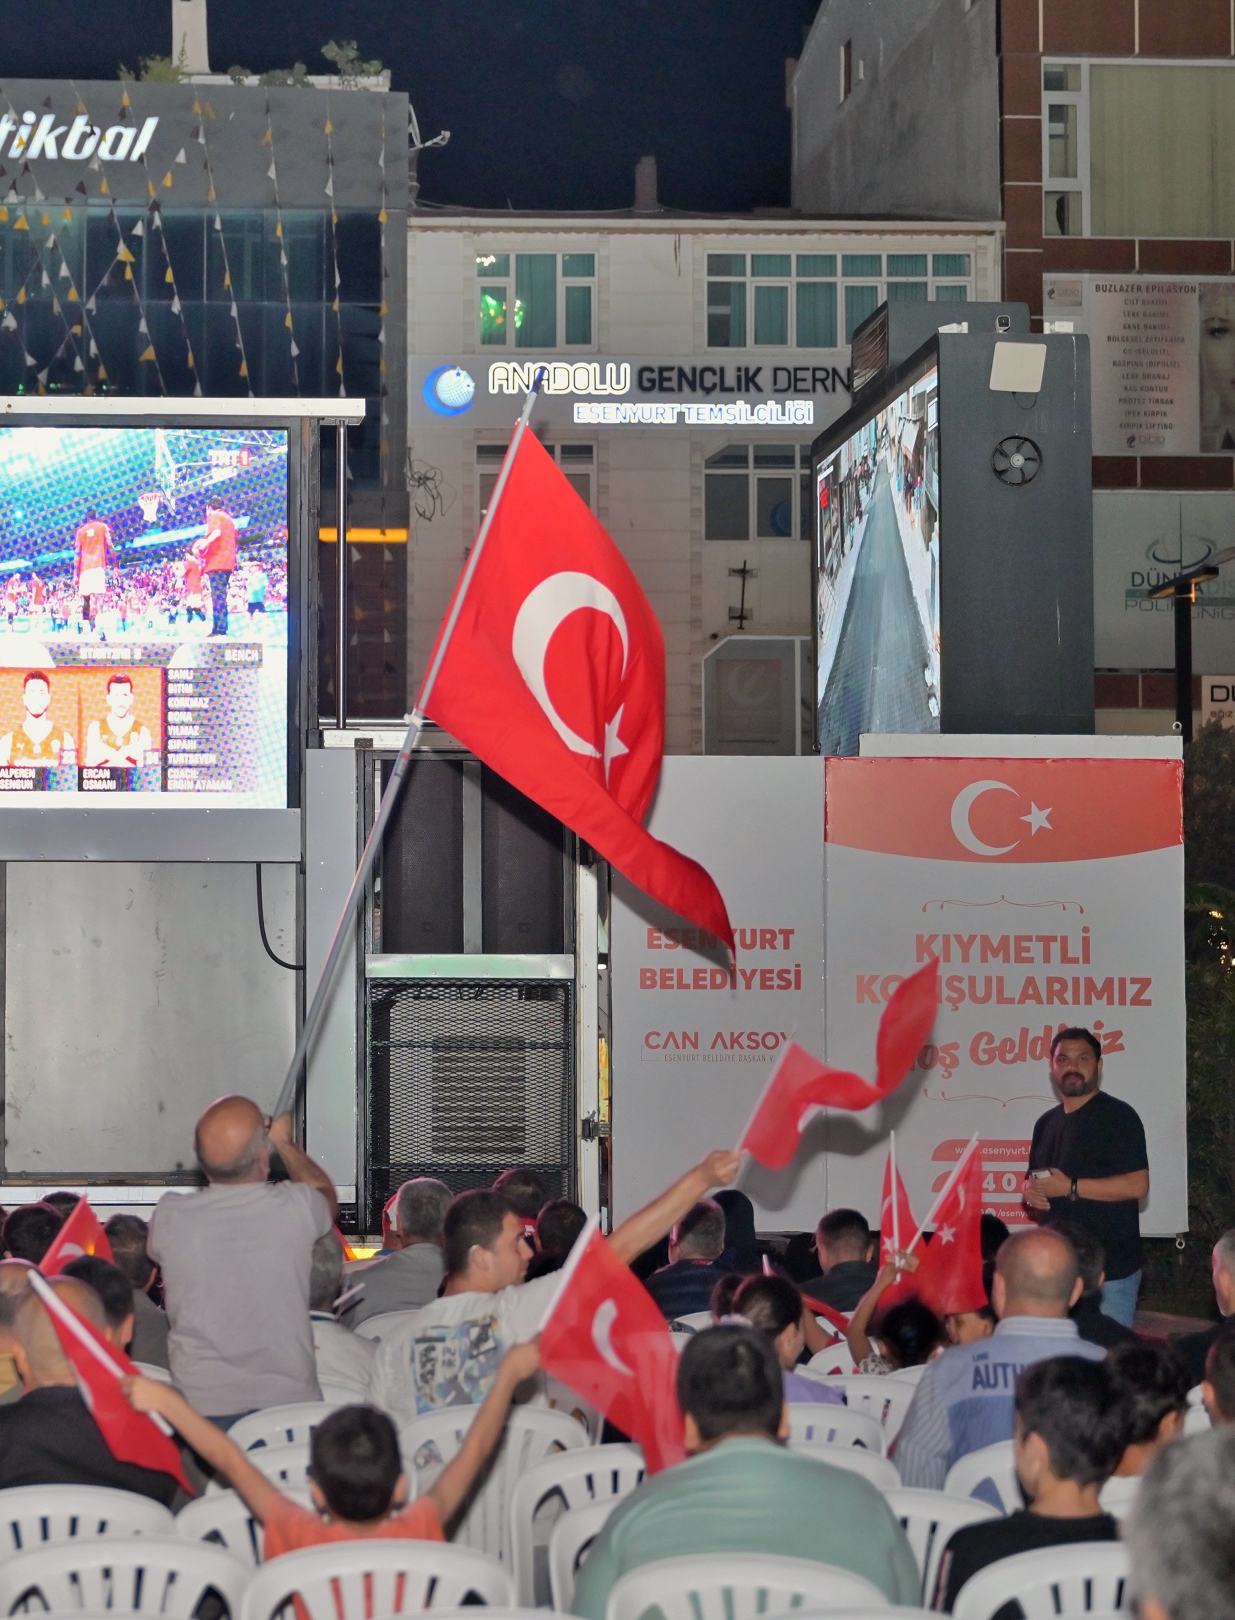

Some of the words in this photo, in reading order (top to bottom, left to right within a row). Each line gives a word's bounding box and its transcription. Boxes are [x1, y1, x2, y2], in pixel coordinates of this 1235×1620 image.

[1095, 283, 1142, 293] BUZLAZER
[490, 363, 630, 394] ANADOLU
[575, 403, 679, 423] ESENYURT
[224, 649, 259, 662] BENCH
[0, 768, 36, 779] ALPEREN
[82, 768, 111, 779] ERCAN
[915, 925, 1091, 965] KIYMETLİ
[639, 963, 802, 991] BELEDİYESİ
[855, 974, 1152, 1011] KOŞULARIMIZ
[644, 1031, 699, 1050] CAN
[664, 1053, 700, 1062] ESENYURT
[702, 1052, 735, 1062] BELEDİYE
[738, 1054, 766, 1063] BAŞKAN
